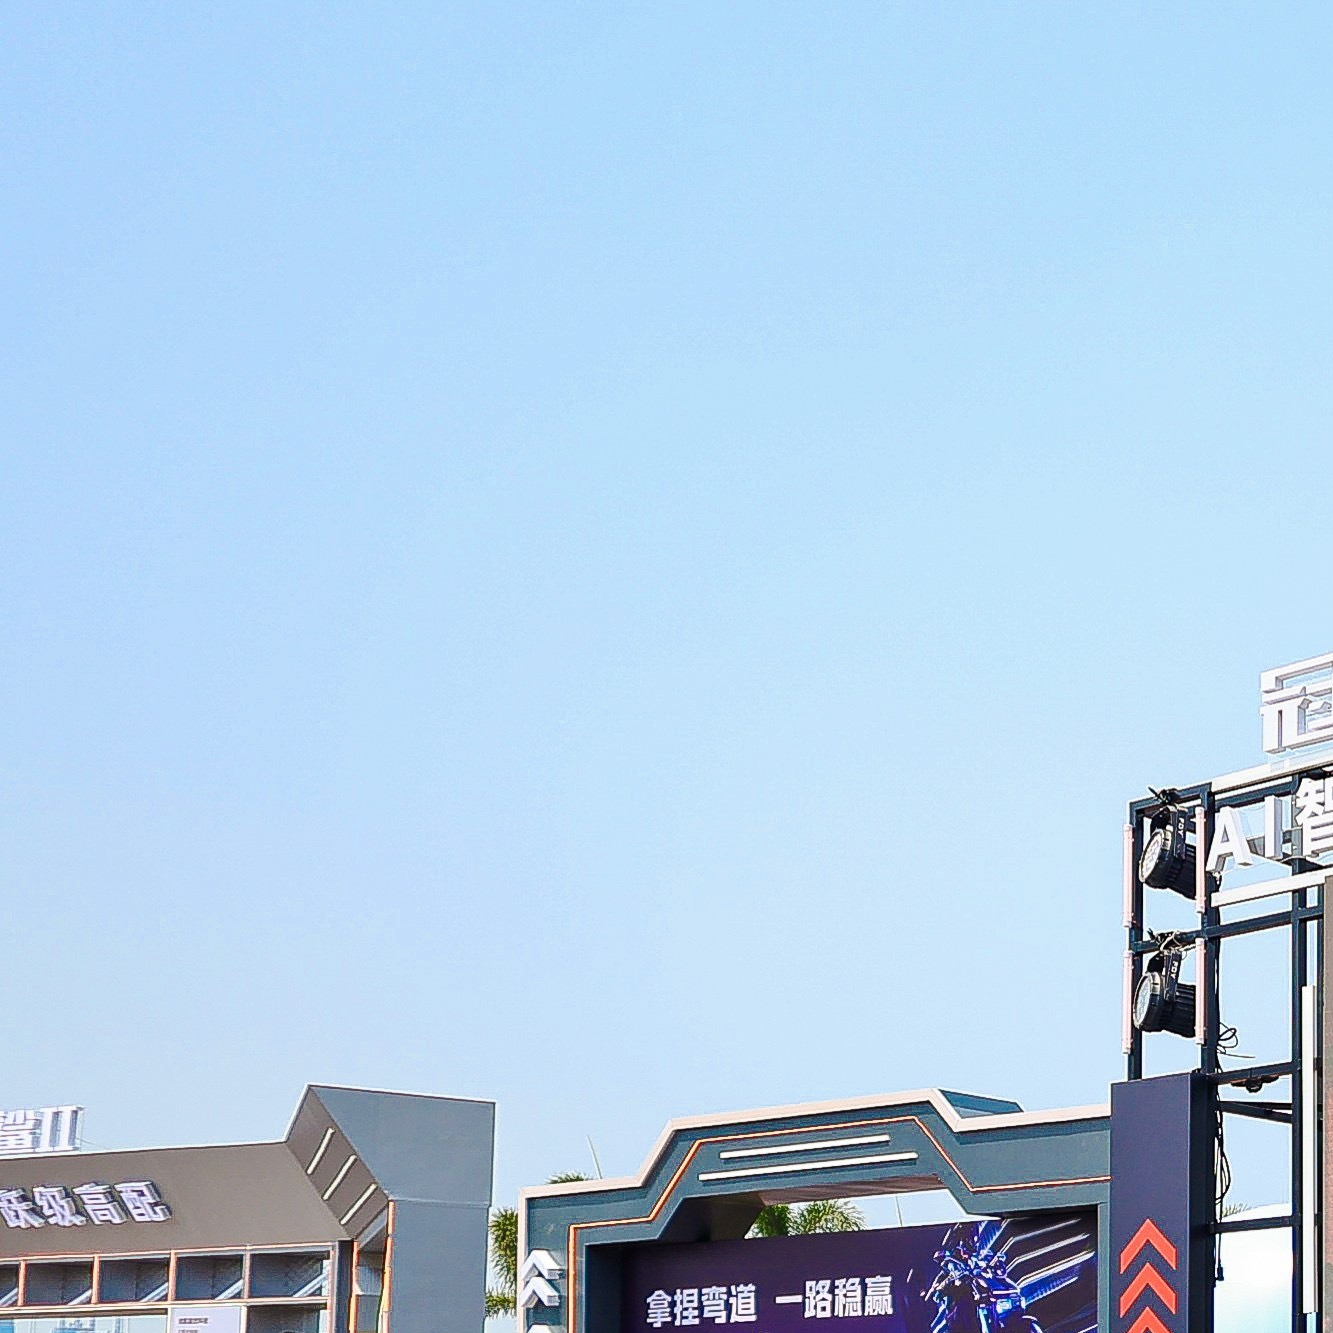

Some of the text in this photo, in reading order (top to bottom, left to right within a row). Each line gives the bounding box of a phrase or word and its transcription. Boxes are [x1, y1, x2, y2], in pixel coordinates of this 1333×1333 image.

[646, 1274, 894, 1328] 拿捏弯道 一路稳赢
